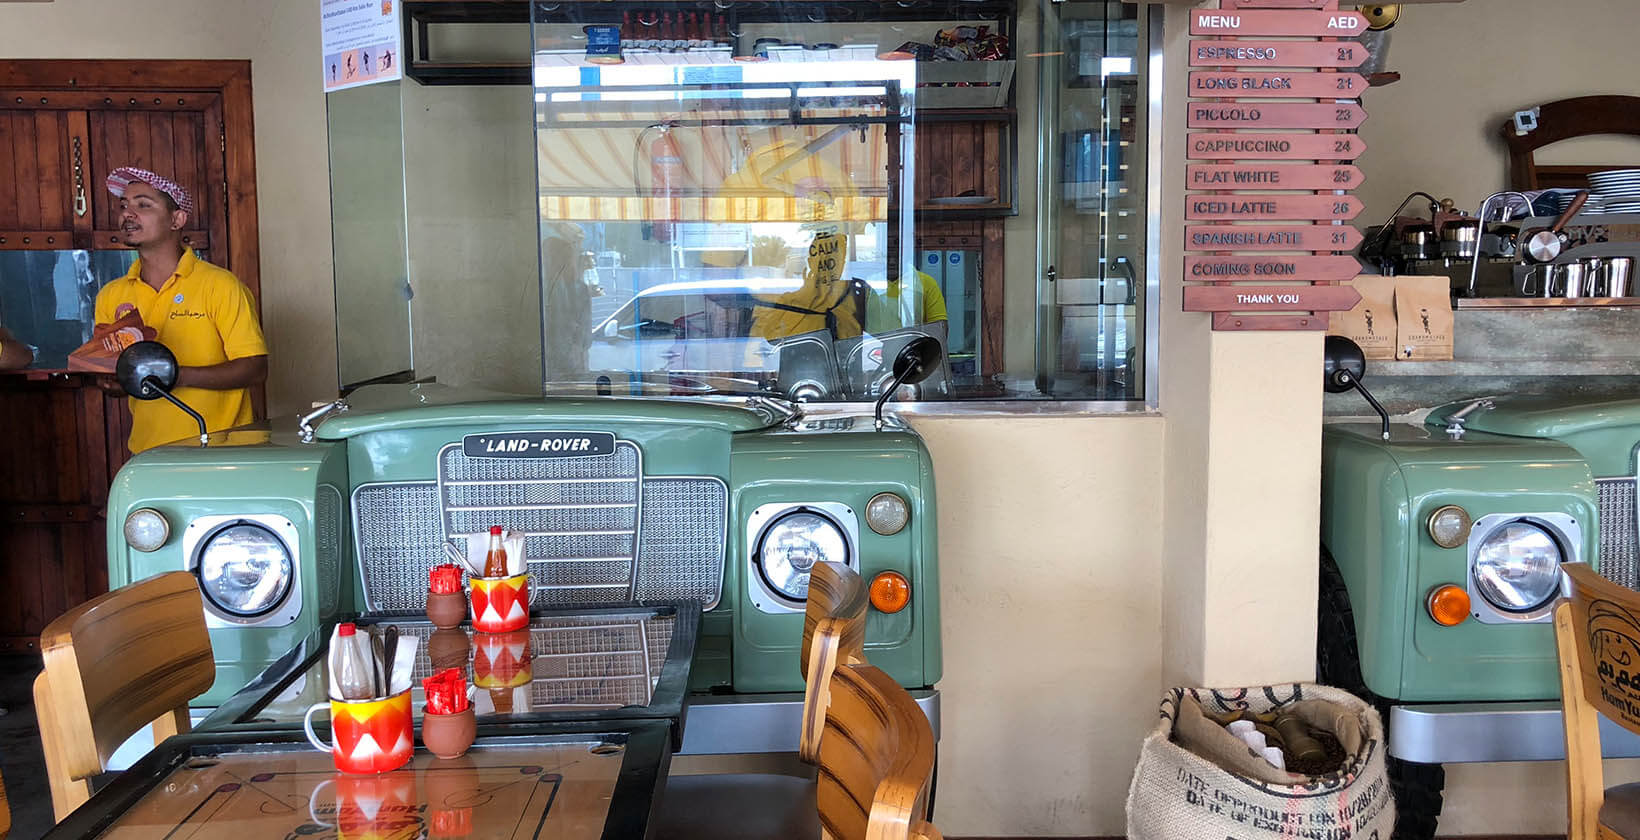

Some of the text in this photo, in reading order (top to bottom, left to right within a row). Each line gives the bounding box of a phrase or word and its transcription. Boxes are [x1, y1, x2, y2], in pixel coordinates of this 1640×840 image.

[1198, 15, 1358, 29] MENU AED
[1197, 47, 1353, 60] ESPRESSO 21
[1196, 77, 1352, 90] LONG BLACK 21
[1196, 109, 1352, 121] PICCOLO 23
[1195, 140, 1351, 153] CAPPUCCINO 24
[1194, 170, 1352, 183] FLAT WHITE 25
[1193, 202, 1349, 214] ICED LATTE 26
[1192, 232, 1347, 246] SPANISH LATTE 31
[1192, 263, 1296, 276] COMING SOON
[1237, 294, 1300, 304] THANK YOU
[486, 438, 591, 452] LAND-ROVER
[1176, 767, 1210, 792] DATE
